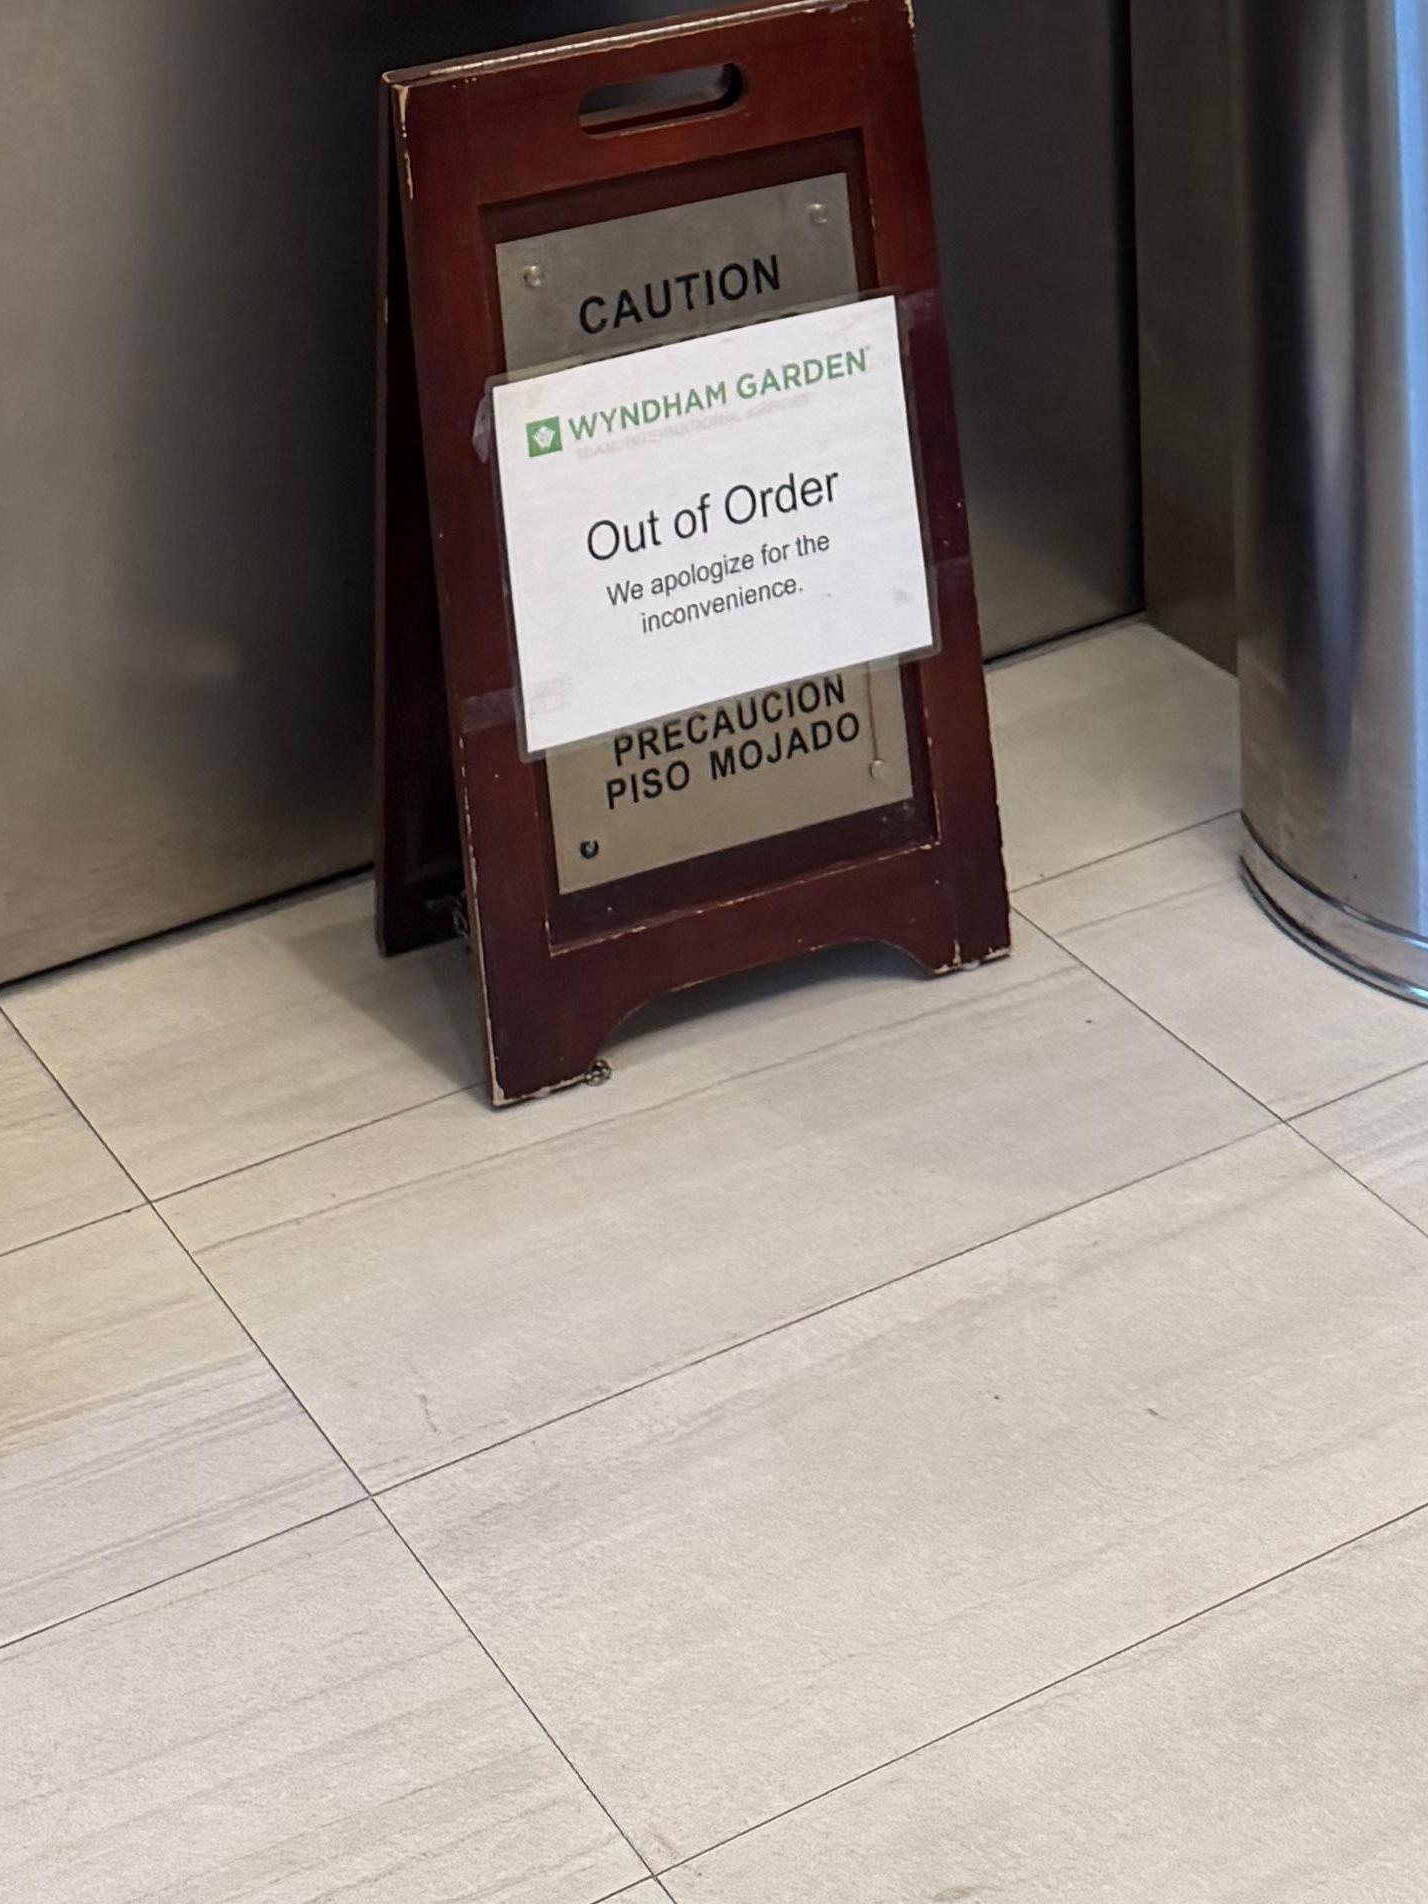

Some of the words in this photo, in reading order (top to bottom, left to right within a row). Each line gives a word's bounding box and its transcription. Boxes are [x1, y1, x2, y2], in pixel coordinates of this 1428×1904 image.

[578, 254, 781, 335] CAUTION
[568, 381, 728, 442] WYNDHAM
[736, 348, 867, 401] GARDEN
[586, 515, 661, 562] Out
[673, 493, 711, 539] of
[724, 469, 839, 527] Order
[606, 581, 644, 607] We
[650, 549, 754, 599] apologize
[760, 539, 790, 566] for
[796, 532, 830, 557] the
[640, 582, 804, 633] inconvenience.
[606, 759, 692, 811] PISO
[710, 711, 862, 781] MOJADO
[613, 673, 847, 767] PRECAUCION
